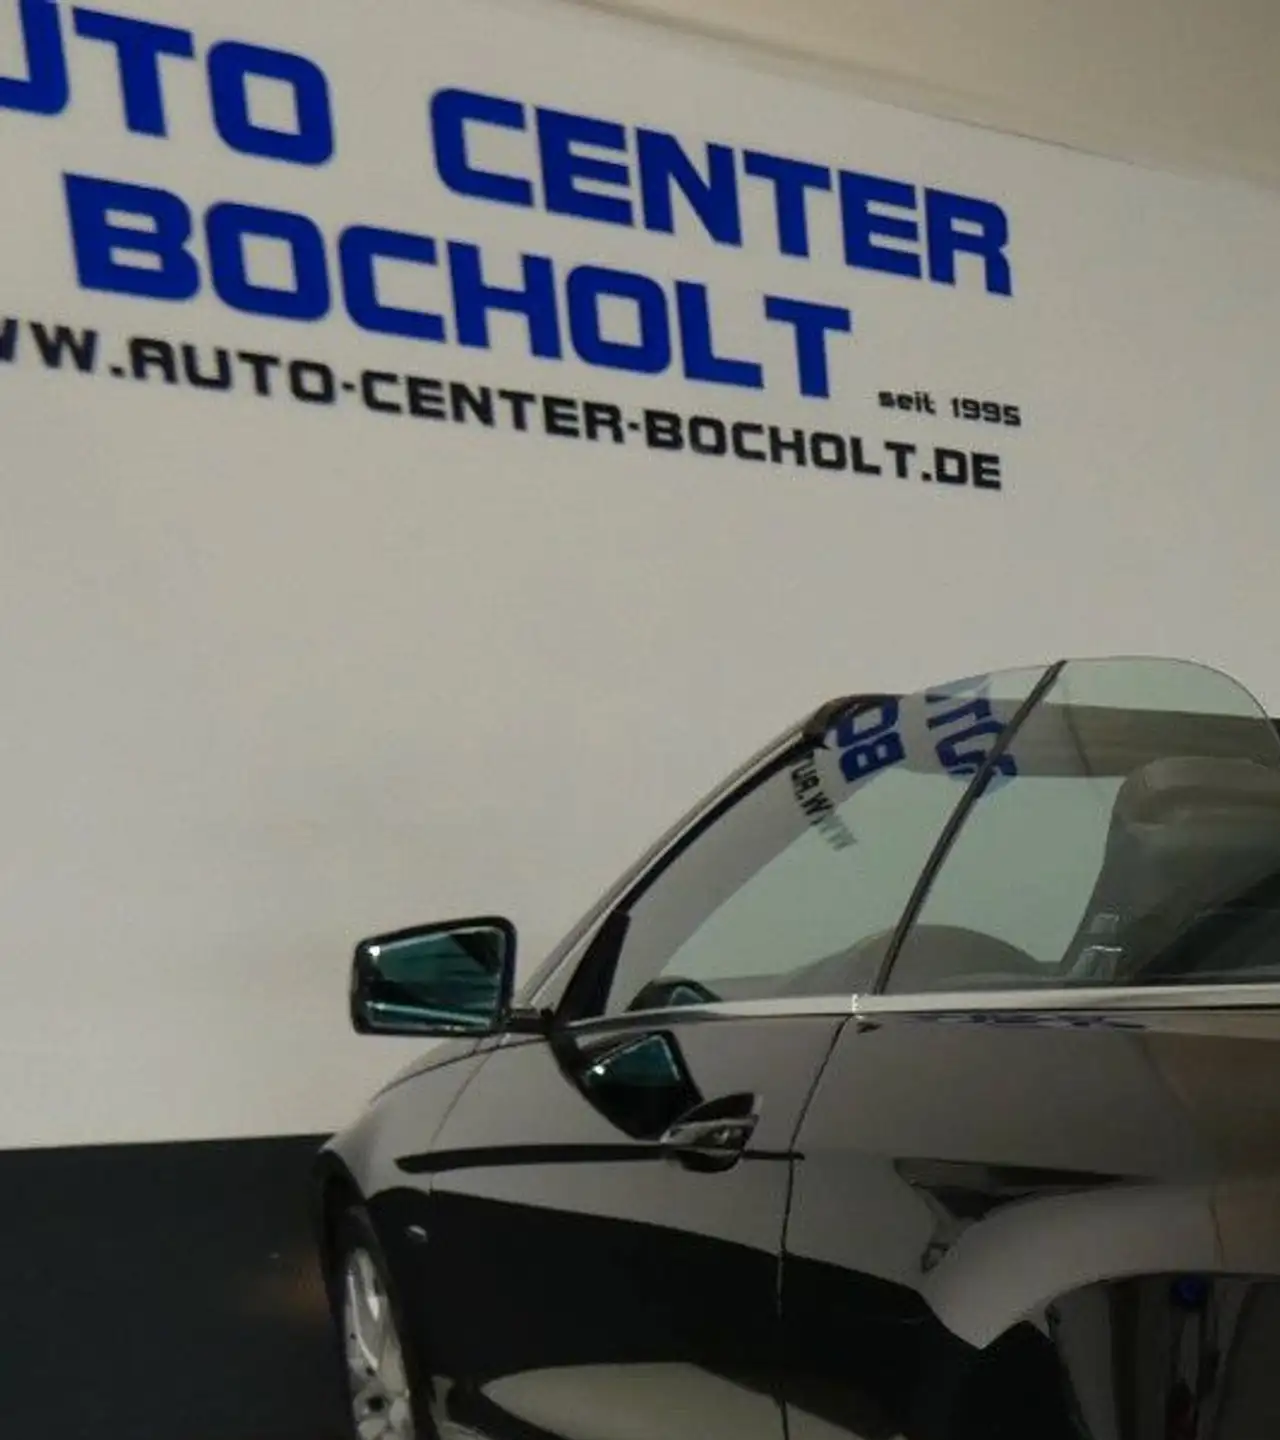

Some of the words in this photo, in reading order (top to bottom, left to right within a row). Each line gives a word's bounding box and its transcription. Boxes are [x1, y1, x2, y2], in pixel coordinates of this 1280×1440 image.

[63, 172, 852, 399] BOCHOLT
[878, 389, 937, 415] seit
[950, 397, 1022, 427] 1995
[430, 87, 1013, 297] CENTER
